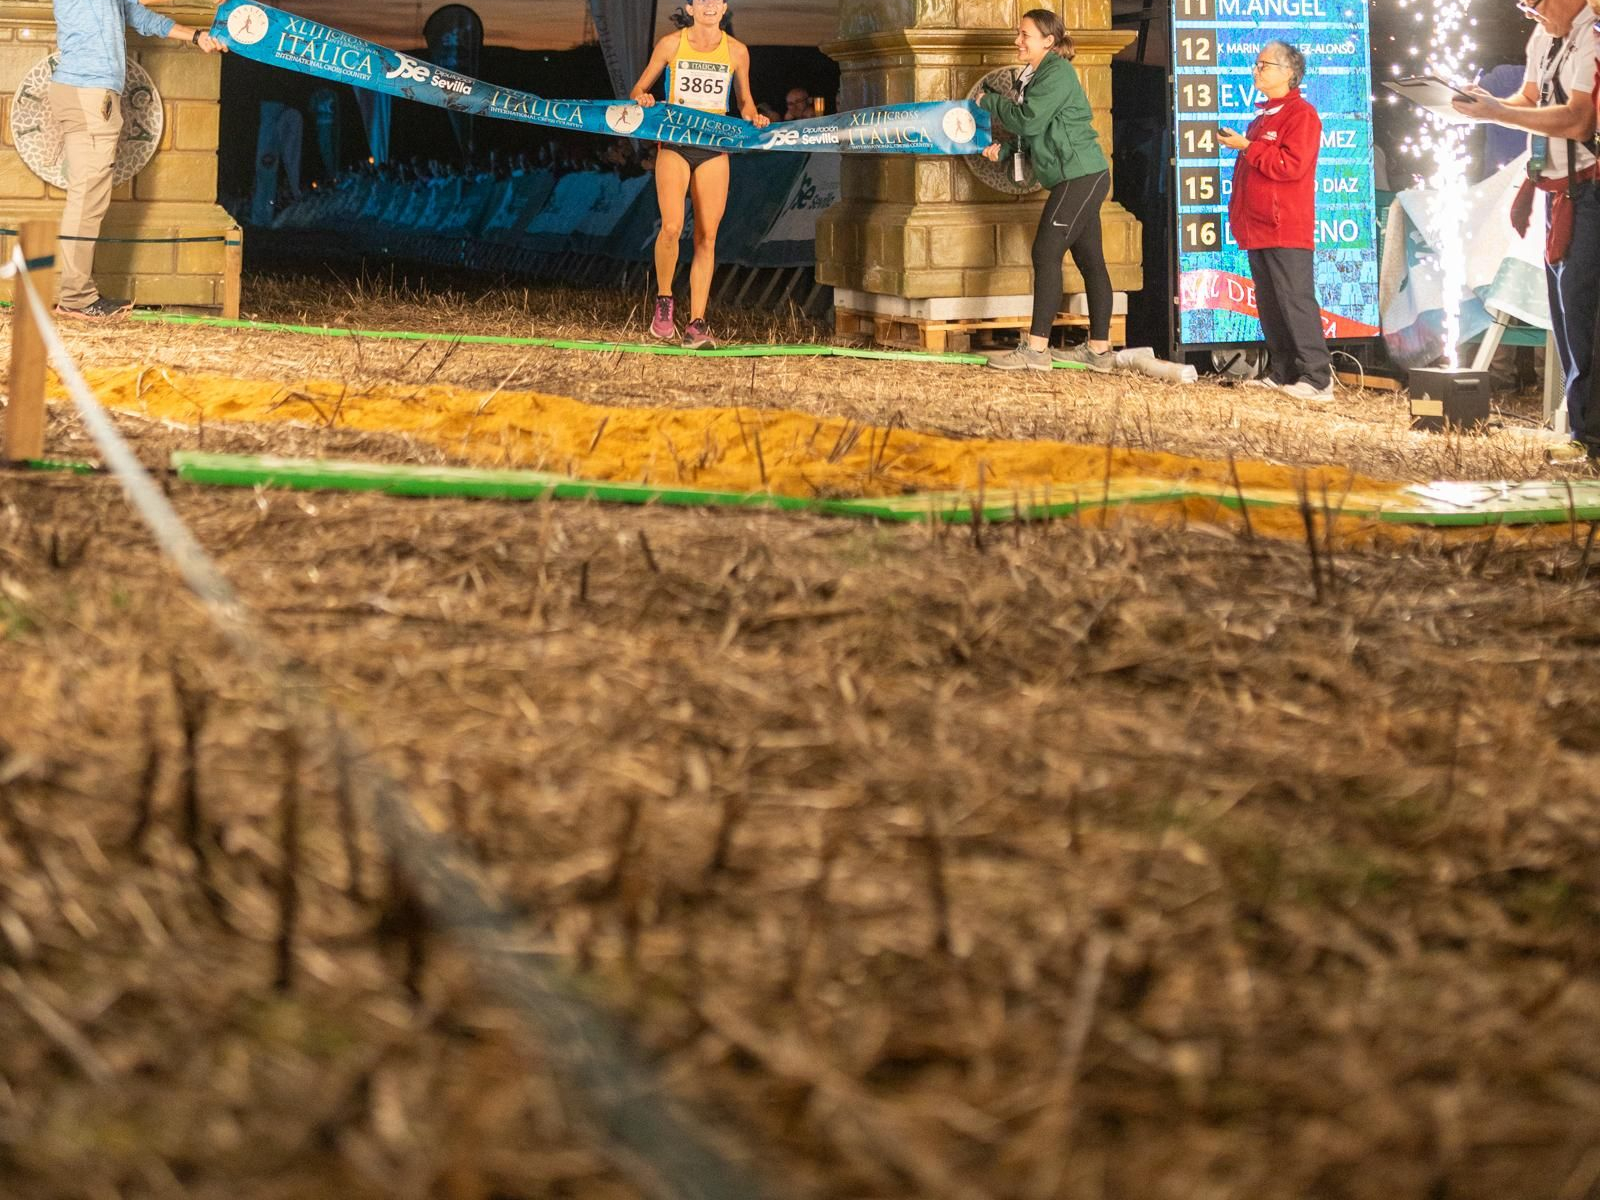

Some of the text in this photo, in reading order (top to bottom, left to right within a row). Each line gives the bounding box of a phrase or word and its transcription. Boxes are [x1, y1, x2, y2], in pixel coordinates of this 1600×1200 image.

[1181, 37, 1211, 61] 12
[430, 75, 472, 95] Sevilla
[680, 76, 723, 94] 3865
[1183, 84, 1212, 107] 13
[887, 110, 920, 122] CROSS
[706, 120, 743, 135] CROSS
[802, 125, 839, 134] Diputación
[801, 132, 839, 145] Sevilla
[1184, 130, 1214, 153] 14
[1185, 176, 1214, 199] 15
[1322, 178, 1359, 193] DIAZ
[1186, 222, 1217, 246] 16
